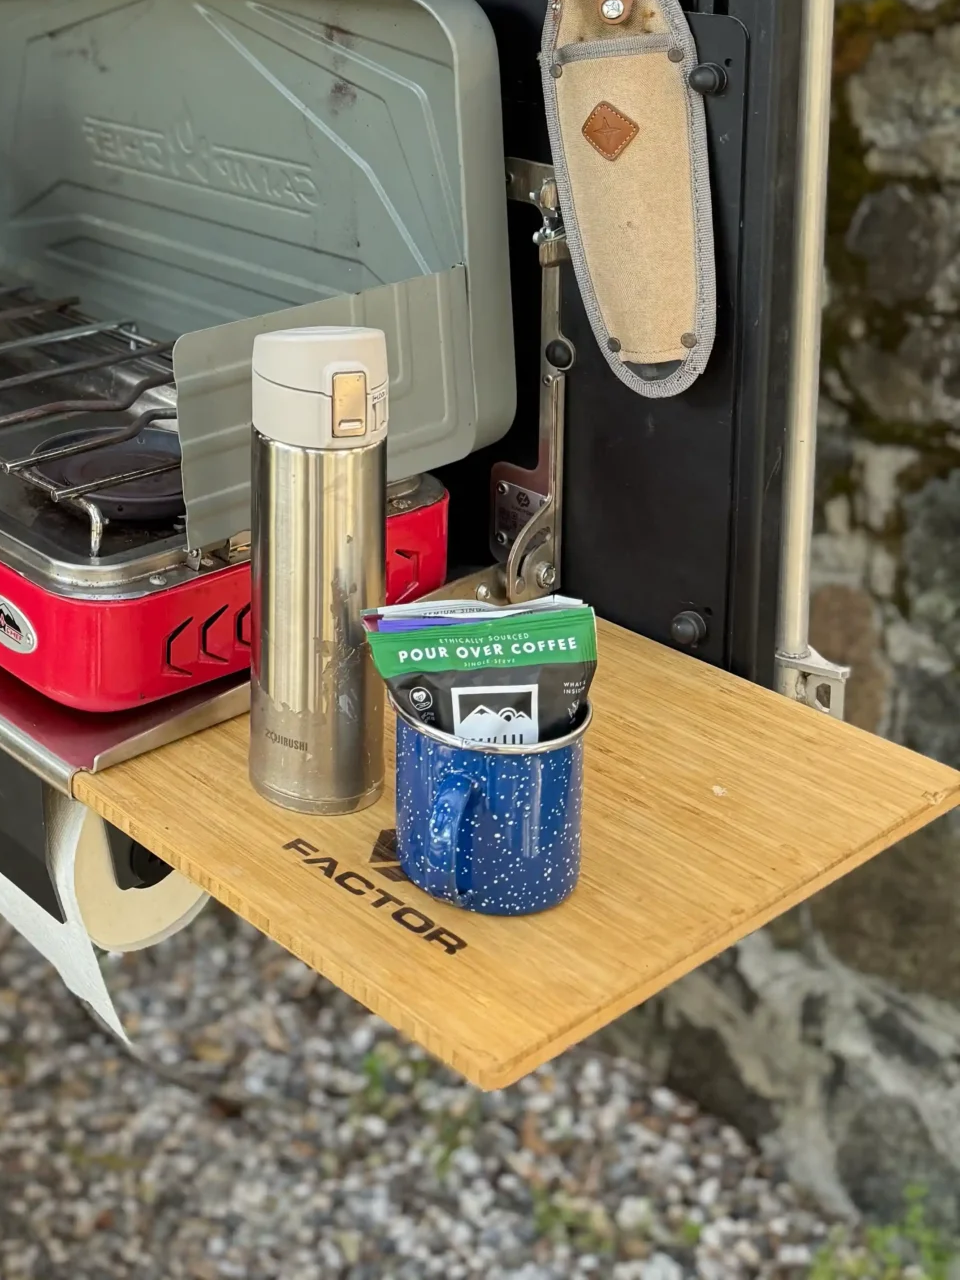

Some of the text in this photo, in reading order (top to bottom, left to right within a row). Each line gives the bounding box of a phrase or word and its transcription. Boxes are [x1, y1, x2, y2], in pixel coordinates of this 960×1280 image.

[398, 637, 578, 663] POUR OVER COFFEE
[488, 633, 529, 642] SOURCED
[265, 728, 308, 752] ZOJIRUSHI
[282, 838, 468, 956] FACTOR
